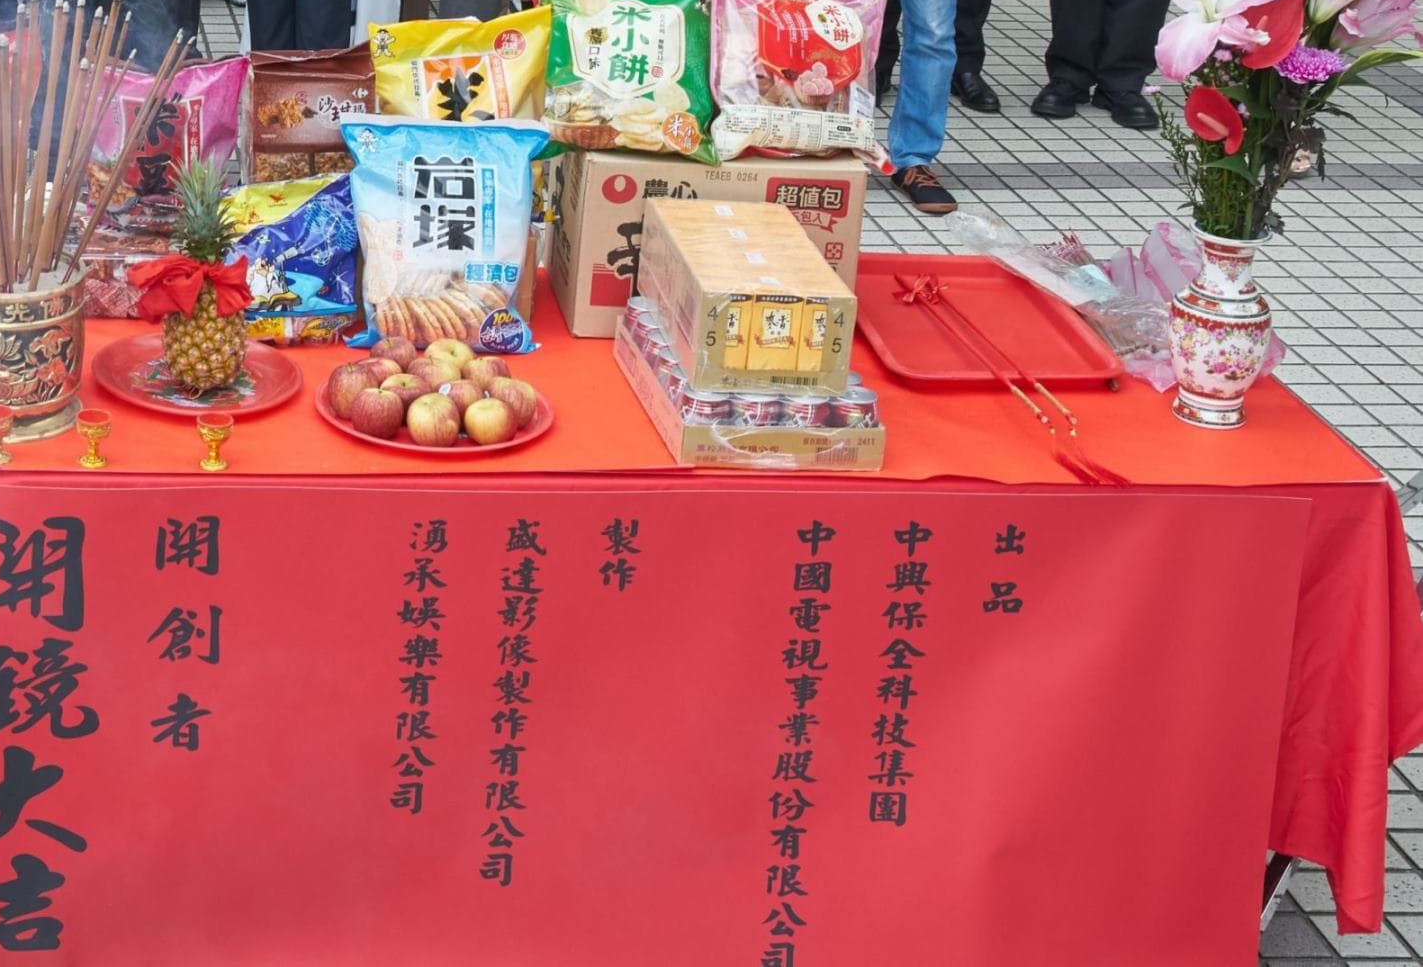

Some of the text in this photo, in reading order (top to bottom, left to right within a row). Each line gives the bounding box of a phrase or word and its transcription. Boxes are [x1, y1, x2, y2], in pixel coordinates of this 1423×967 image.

[607, 5, 652, 86] 米小餅
[776, 185, 842, 209] 超值包
[465, 262, 520, 284] 經濟包
[705, 331, 717, 347] 5
[707, 307, 718, 321] 4
[832, 338, 842, 353] 5
[834, 312, 845, 328] 4
[599, 518, 641, 592] 製作
[982, 523, 1026, 614] 出品
[147, 515, 223, 752] 開創者
[390, 519, 448, 815] 湧承娛樂有限公司
[479, 518, 547, 887] 盛達影像製作有限公司
[868, 520, 933, 827] 中興保全科技集團
[761, 519, 837, 967] 中國電視事業股份有限公司
